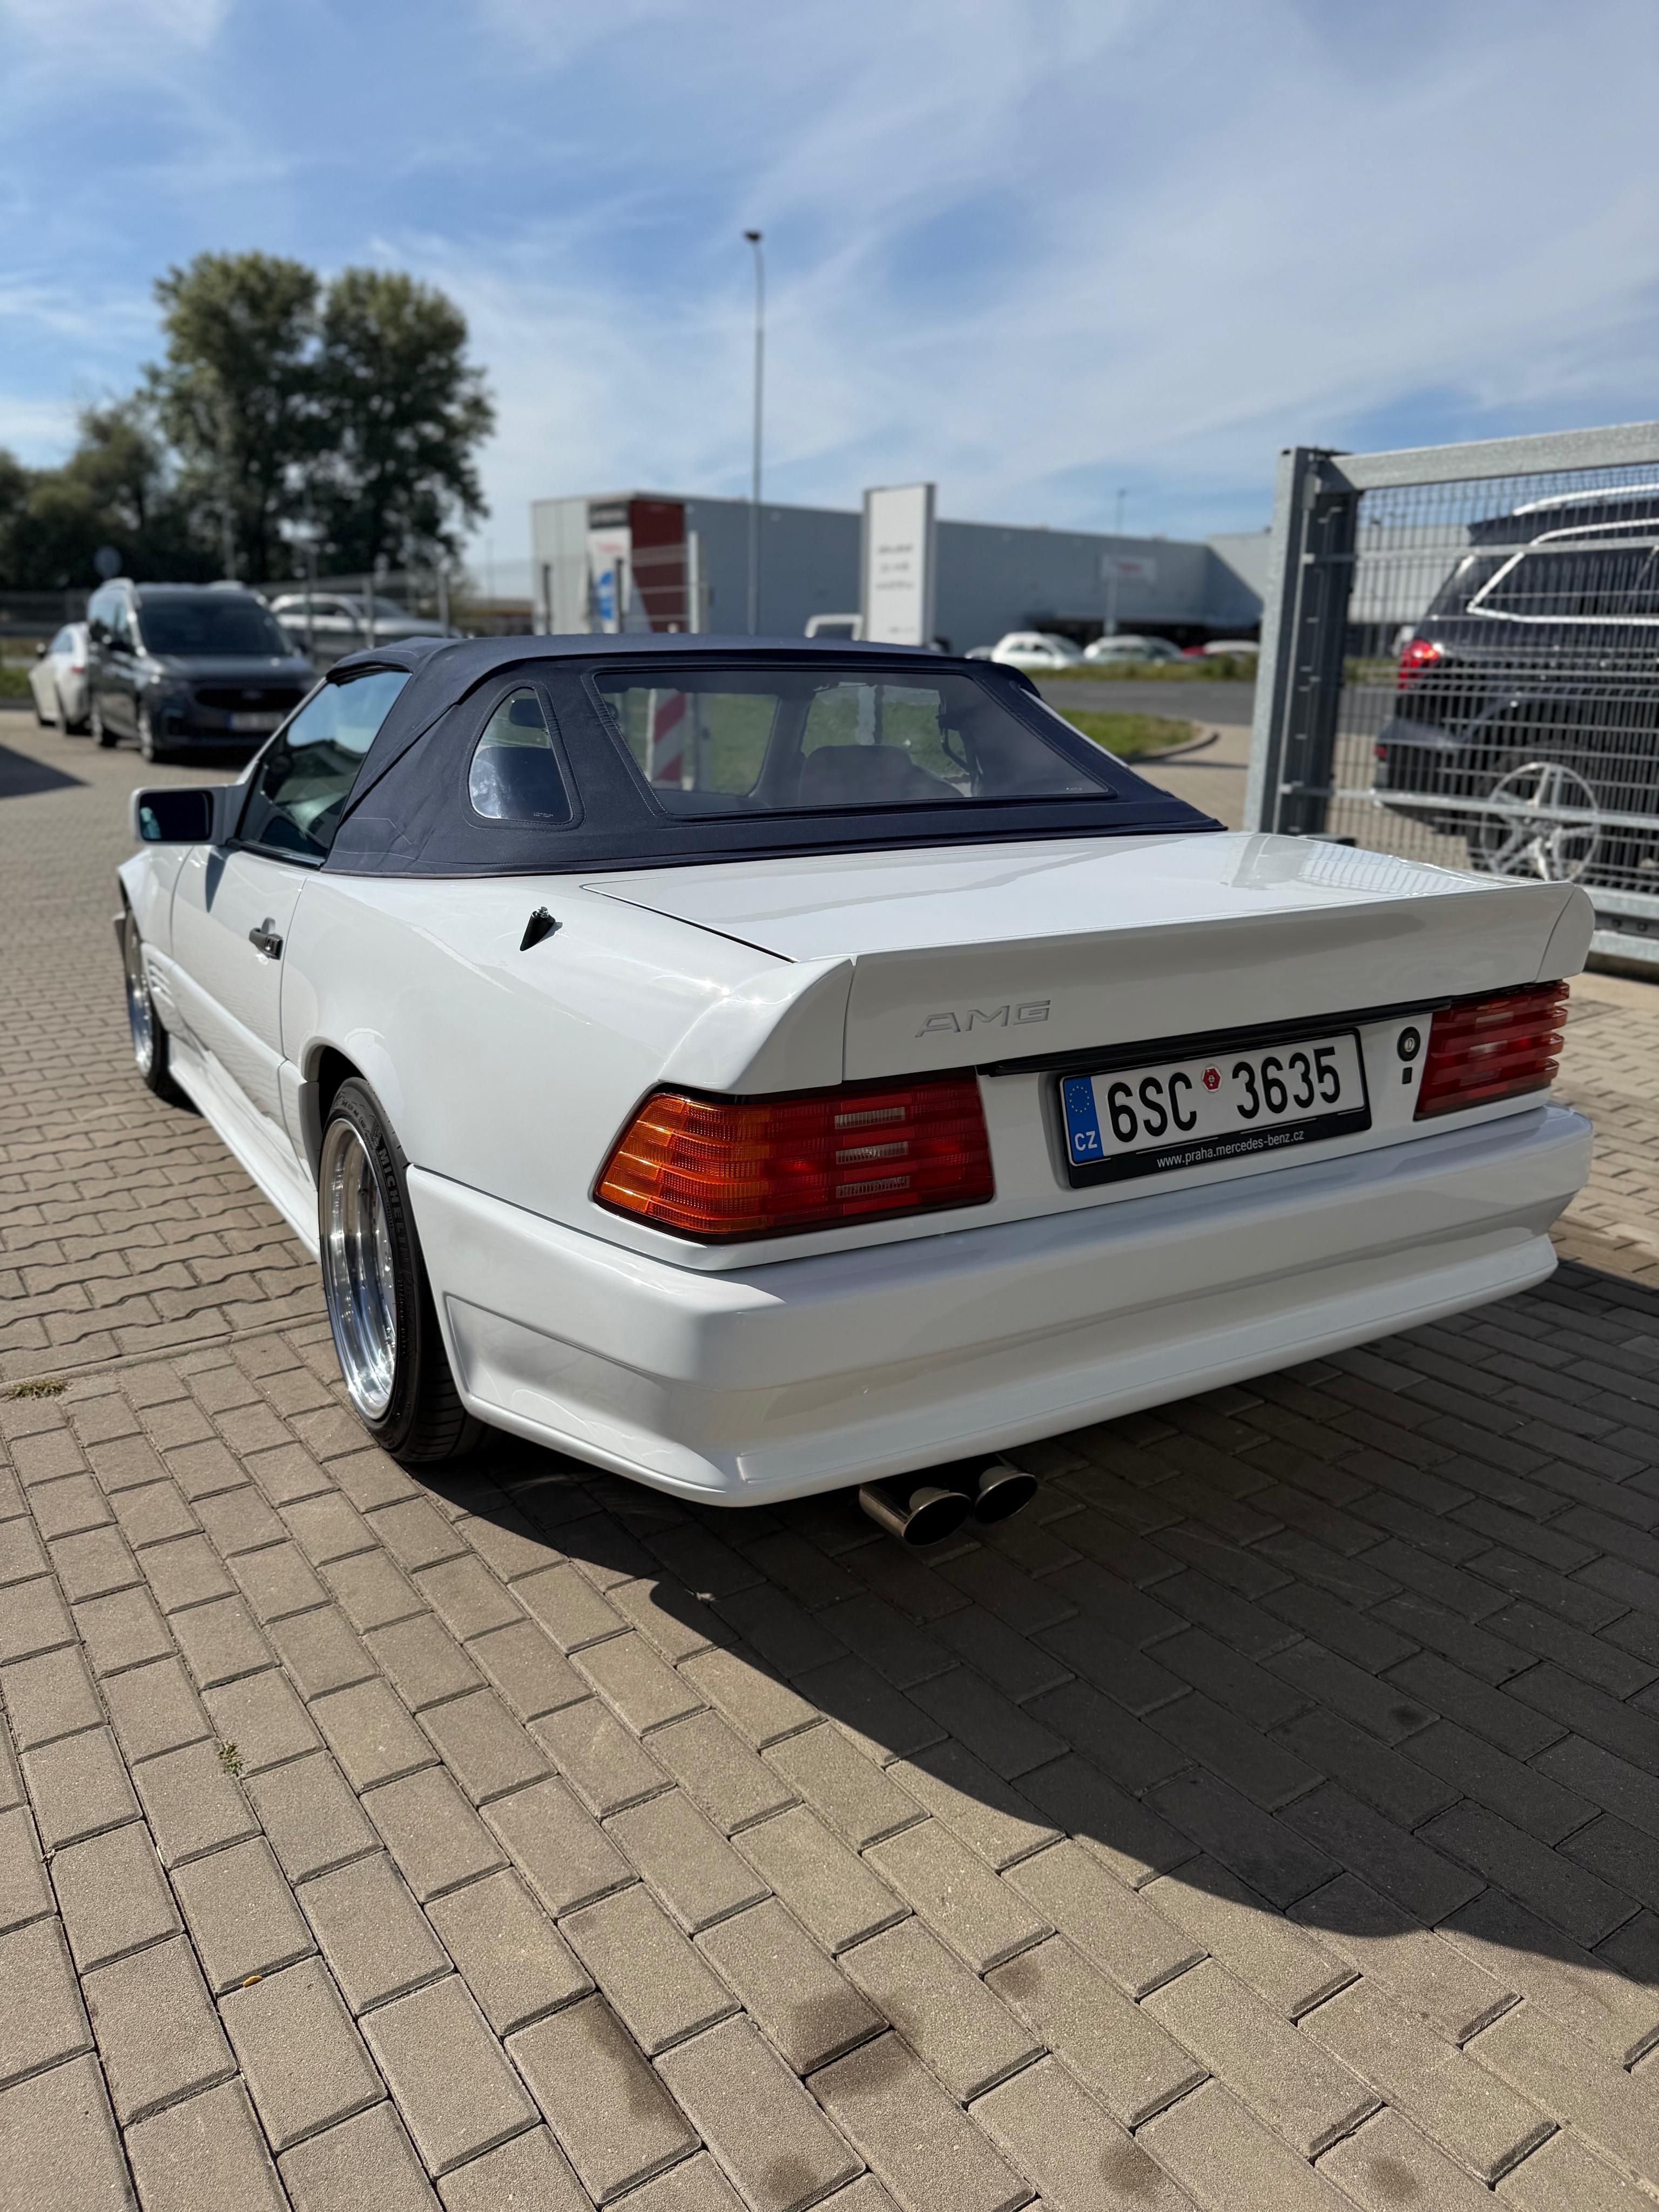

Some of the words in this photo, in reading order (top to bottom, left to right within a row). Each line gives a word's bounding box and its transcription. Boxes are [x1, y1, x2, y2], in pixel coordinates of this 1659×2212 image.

[914, 1000, 1051, 1038] AMG
[1107, 1072, 1197, 1143] 6SC
[1231, 1046, 1340, 1120] 3635
[1075, 1130, 1097, 1151] CZ
[1157, 1131, 1305, 1168] www.praha.mercedes-benz.cz
